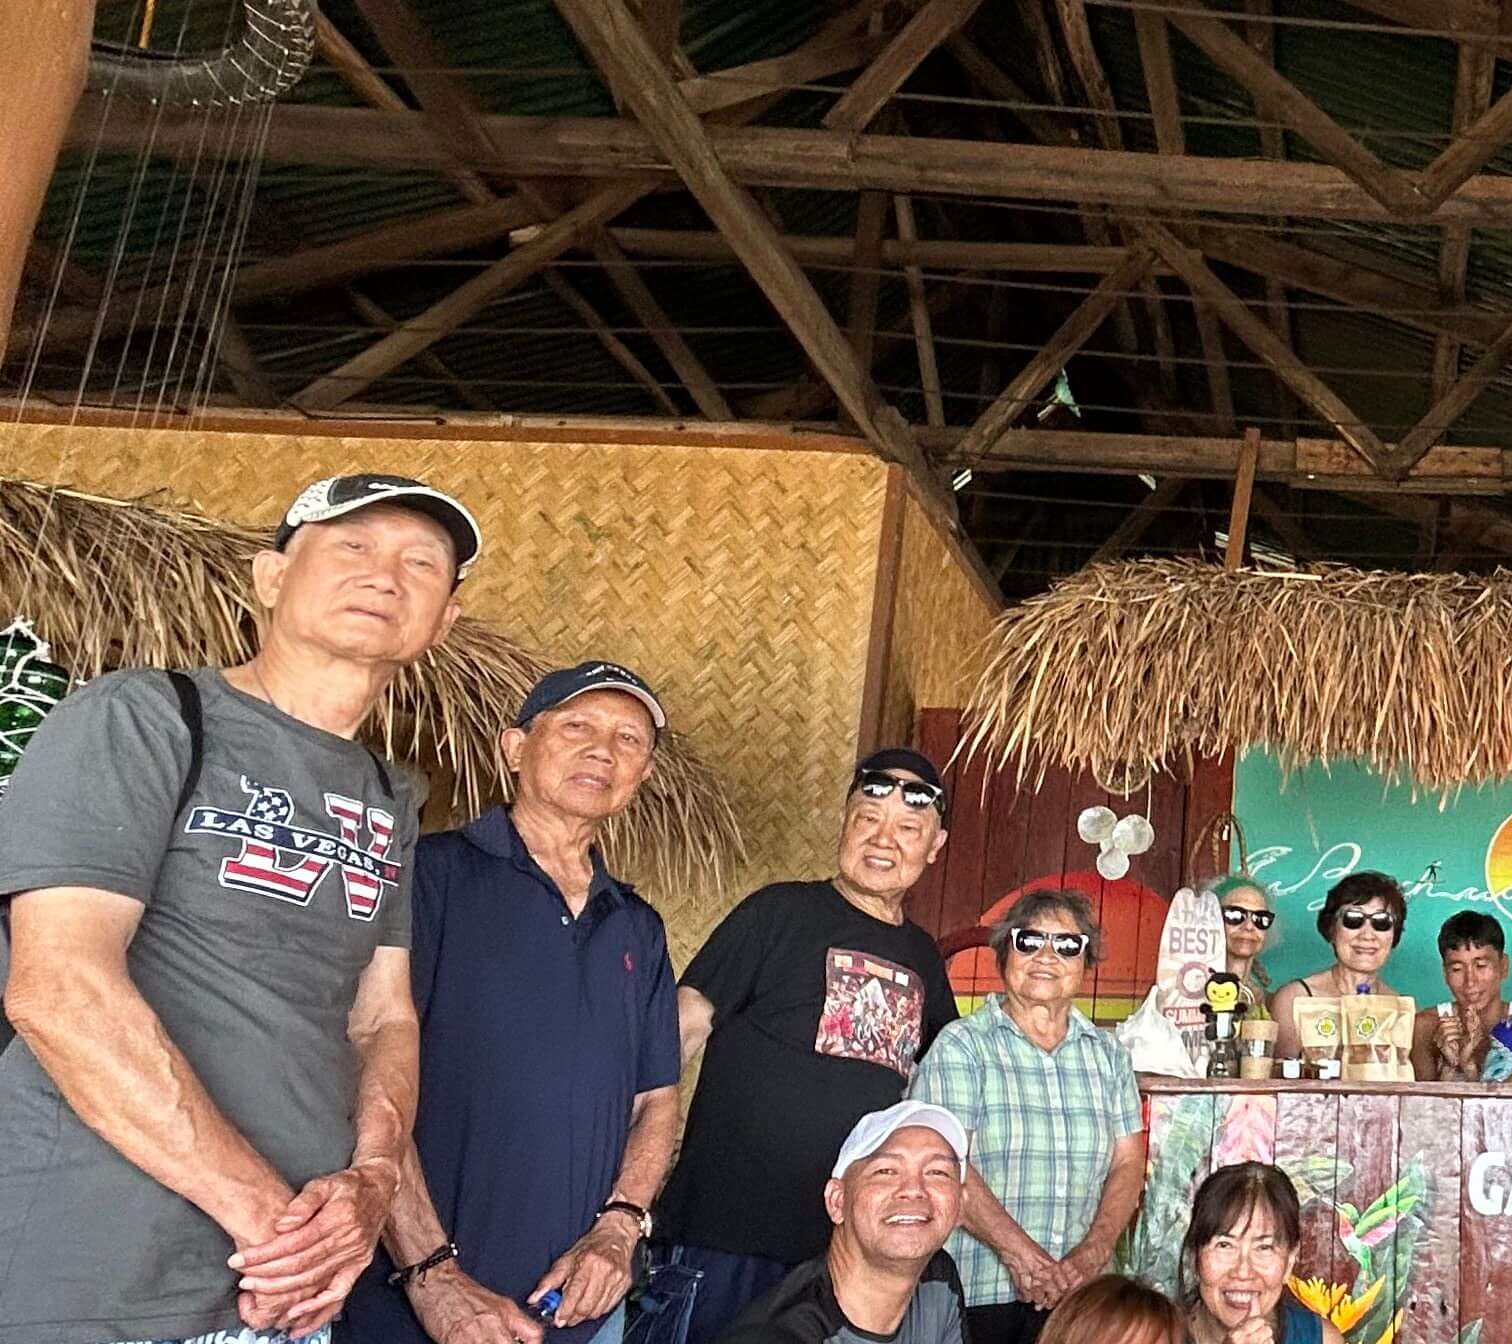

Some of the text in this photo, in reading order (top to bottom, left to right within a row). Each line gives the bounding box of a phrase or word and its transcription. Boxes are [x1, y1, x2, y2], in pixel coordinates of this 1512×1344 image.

[199, 810, 274, 841] LAS
[289, 829, 381, 876] VEGAS,
[1169, 927, 1220, 955] BEST
